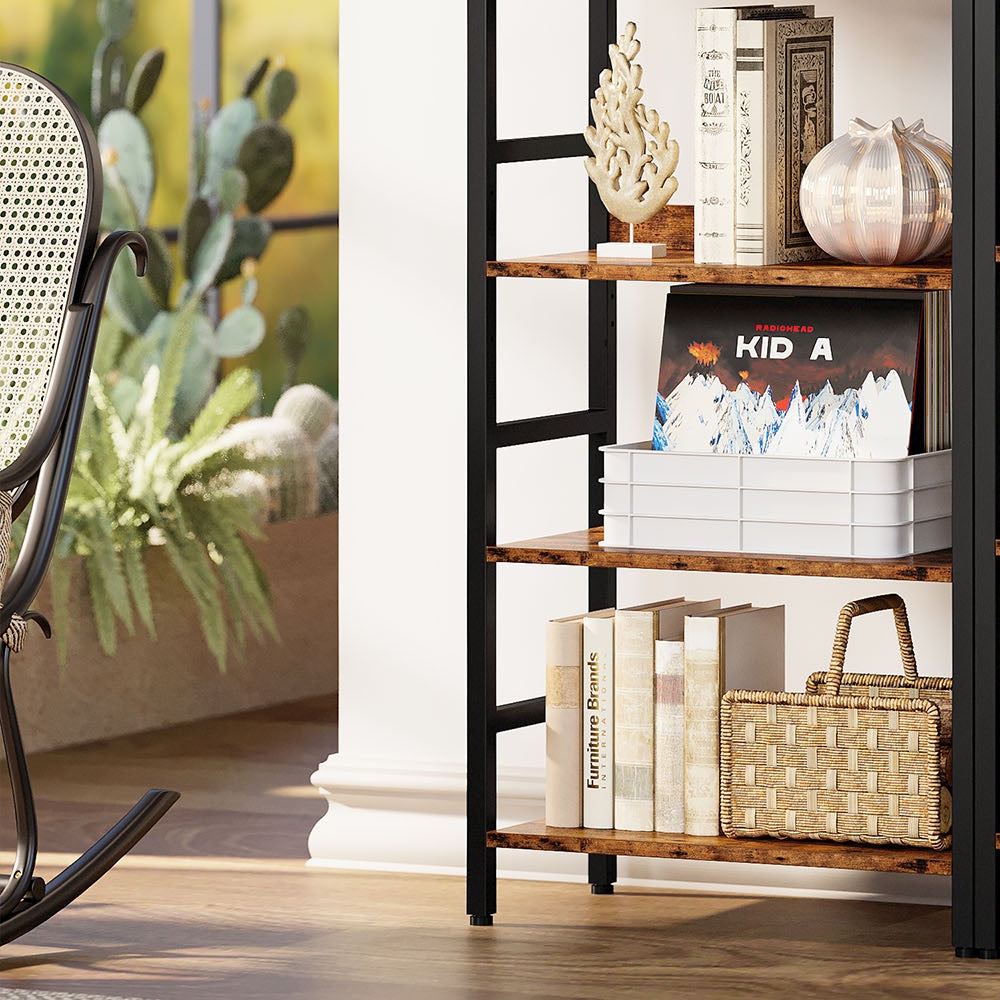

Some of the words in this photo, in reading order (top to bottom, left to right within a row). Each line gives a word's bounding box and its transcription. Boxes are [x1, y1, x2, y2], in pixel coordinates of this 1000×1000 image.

[736, 335, 794, 360] KID
[809, 337, 833, 361] A
[755, 324, 814, 333] RADIOHEAD
[587, 652, 599, 711] Brands
[587, 715, 599, 789] Furniture
